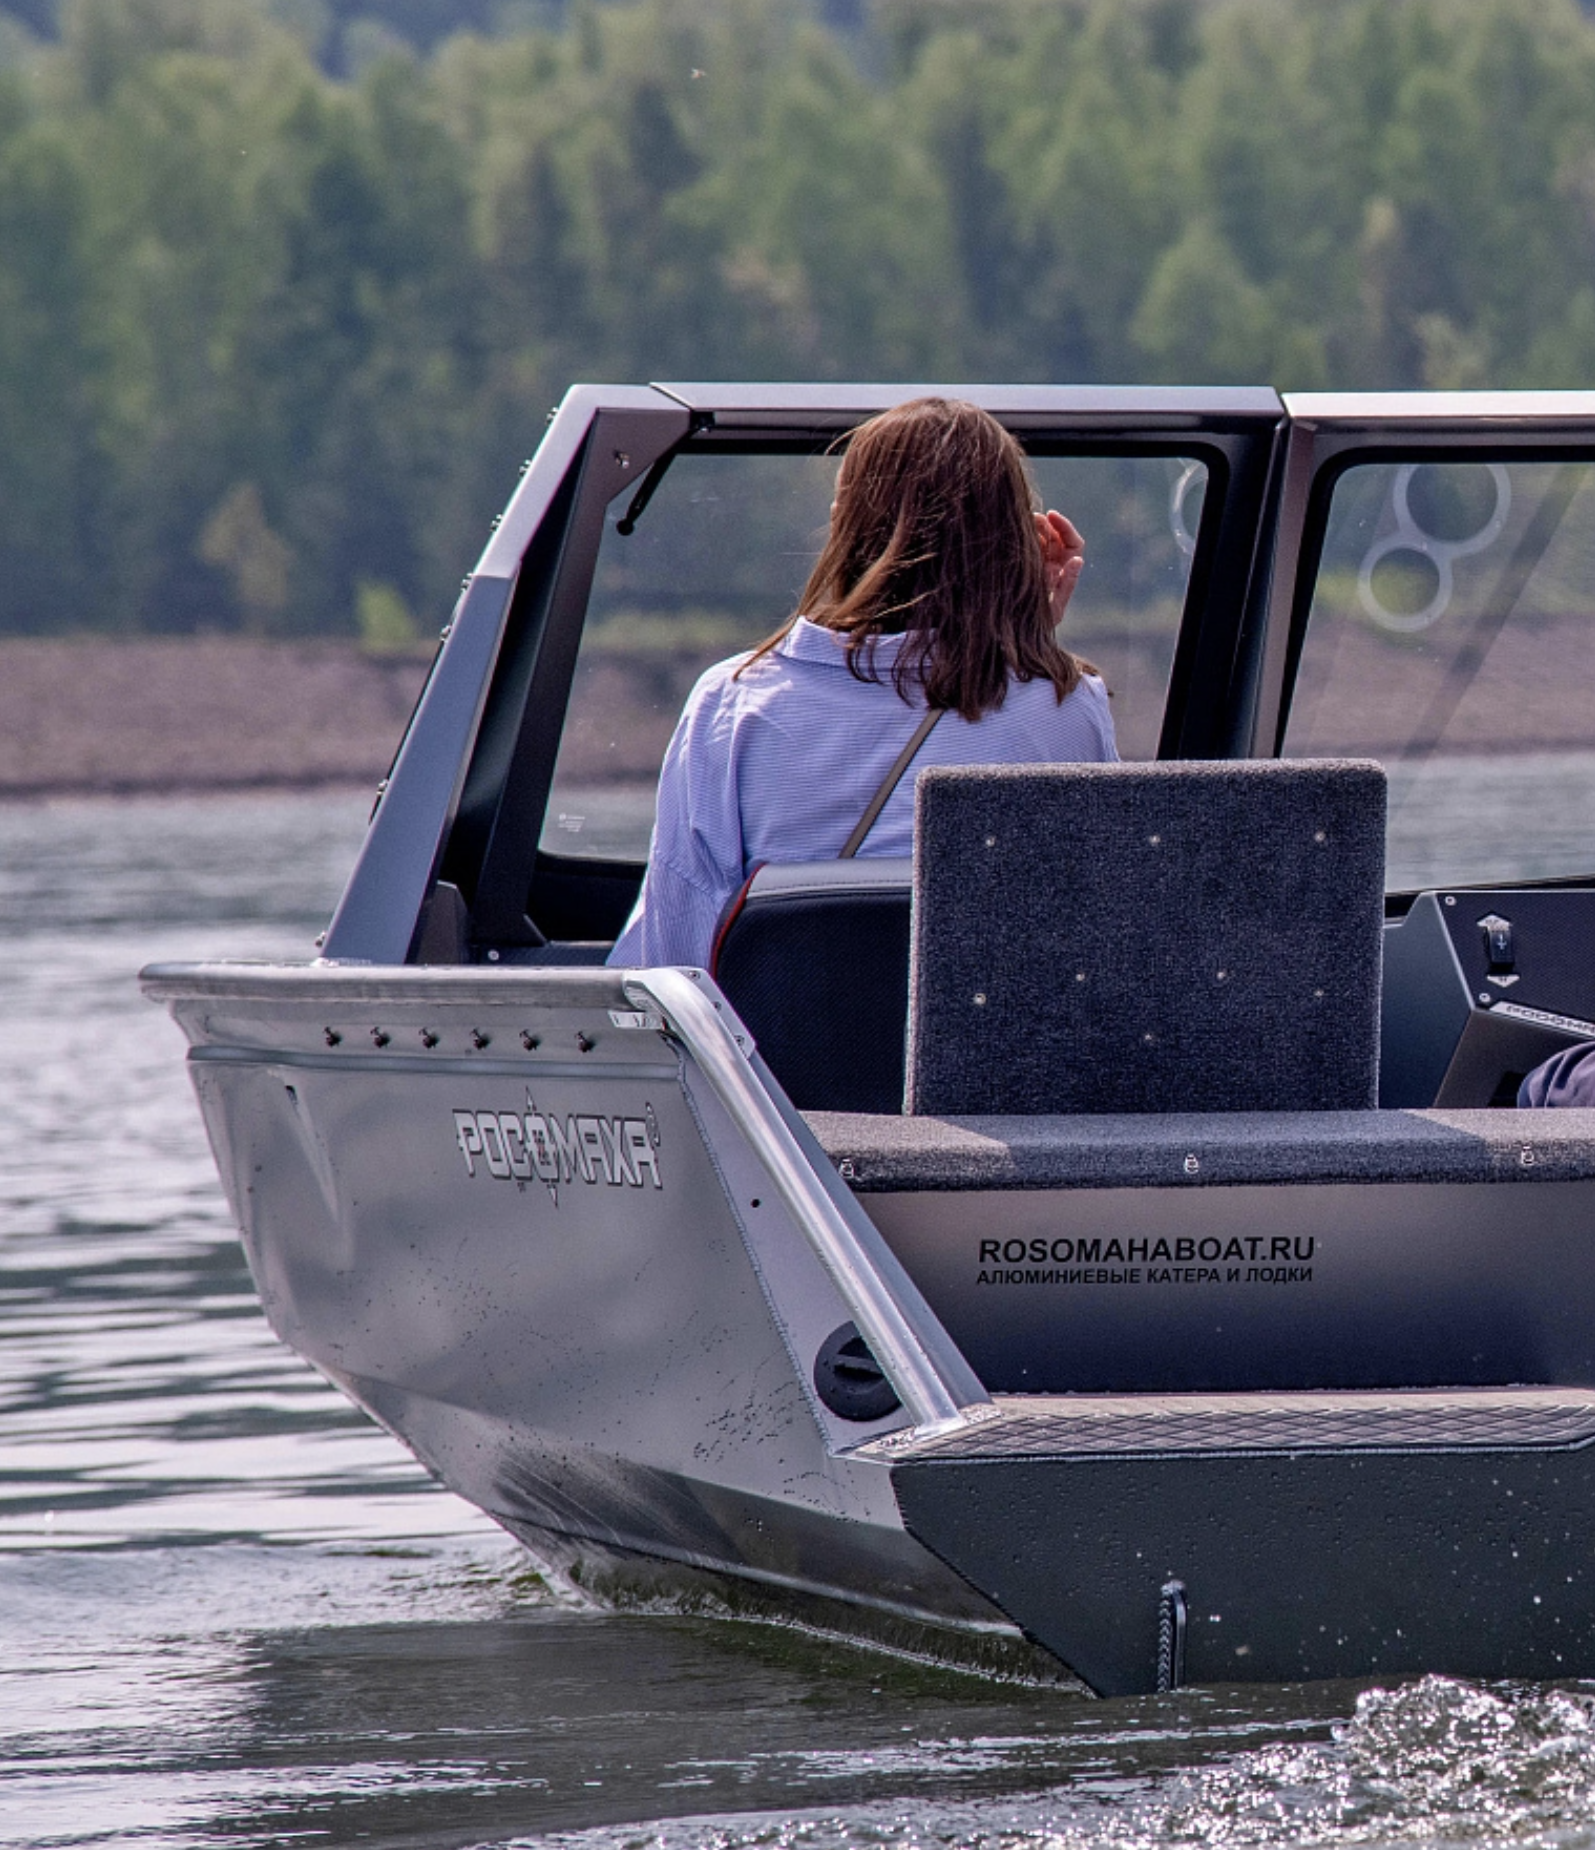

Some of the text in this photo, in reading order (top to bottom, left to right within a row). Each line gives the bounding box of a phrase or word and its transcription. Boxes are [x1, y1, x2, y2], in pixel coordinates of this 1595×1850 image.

[451, 1107, 664, 1190] РОСОМАХА
[978, 1237, 1315, 1263] ROSOMAHABOAT.RU
[976, 1267, 1313, 1285] АЛЮМИНИЕВЫЕ КАТЕРА И ЛОДКИ
